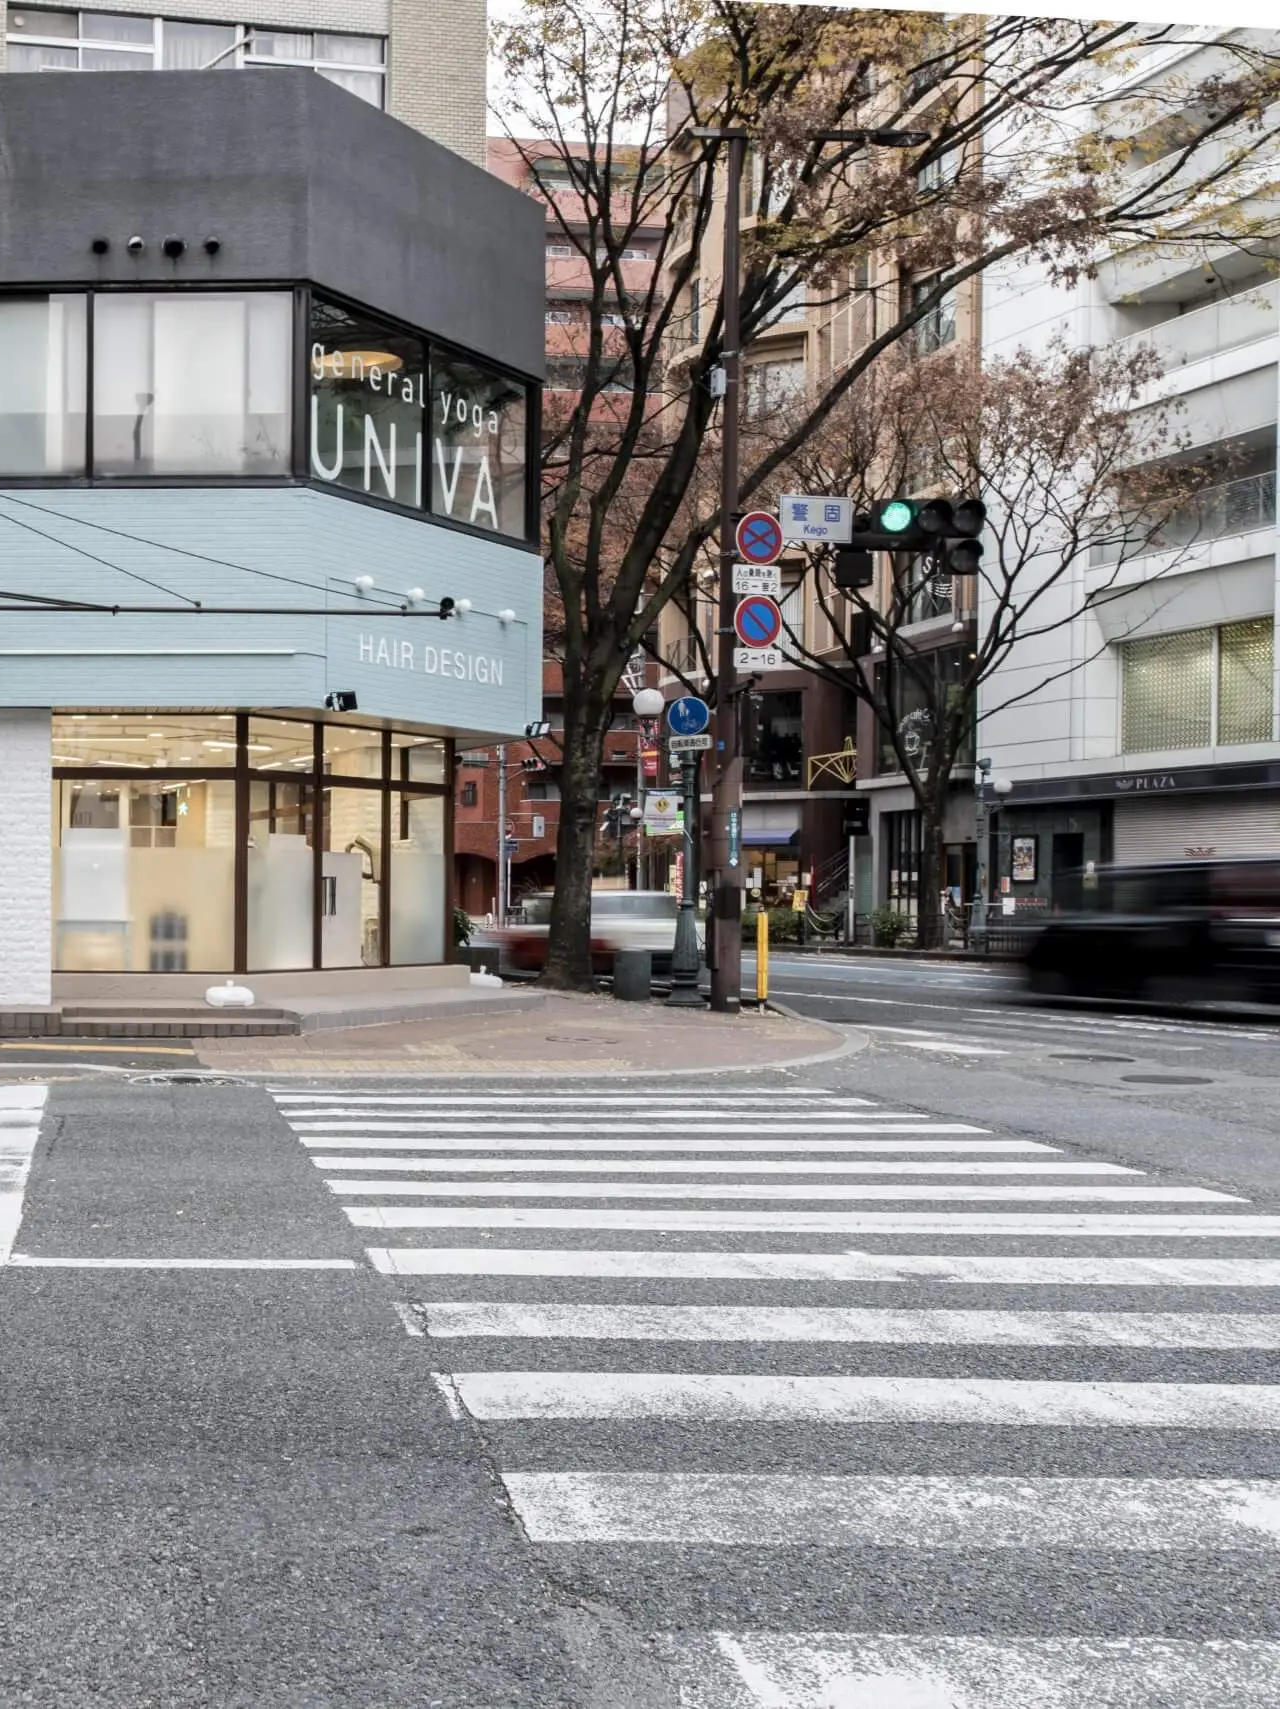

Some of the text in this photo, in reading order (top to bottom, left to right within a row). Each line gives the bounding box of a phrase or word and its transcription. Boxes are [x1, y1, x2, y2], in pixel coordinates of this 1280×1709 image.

[311, 342, 497, 437] general yoga
[311, 395, 498, 529] UNIVA
[803, 525, 828, 536] Kego
[359, 633, 503, 686] HAIR DESIGN
[740, 652, 775, 665] 2-16
